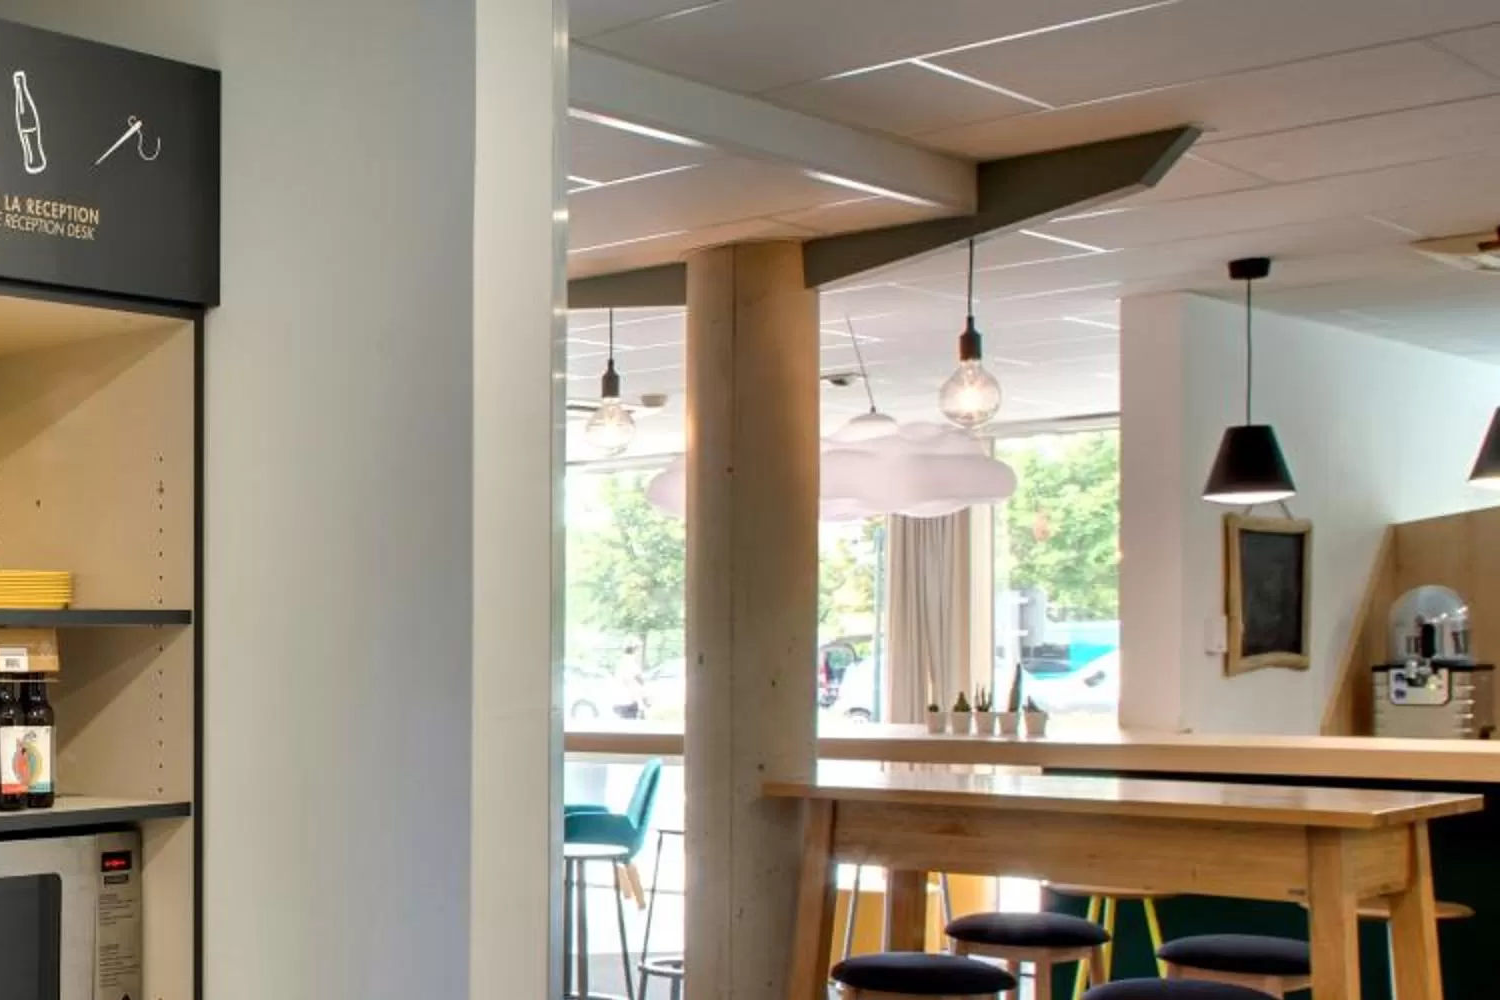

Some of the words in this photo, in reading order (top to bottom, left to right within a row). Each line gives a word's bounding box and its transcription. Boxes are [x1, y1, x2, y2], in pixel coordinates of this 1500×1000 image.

[4, 194, 22, 213] LA
[27, 198, 100, 225] RECEPTION
[5, 213, 65, 236] RECEPTION
[66, 222, 97, 241] DESK
